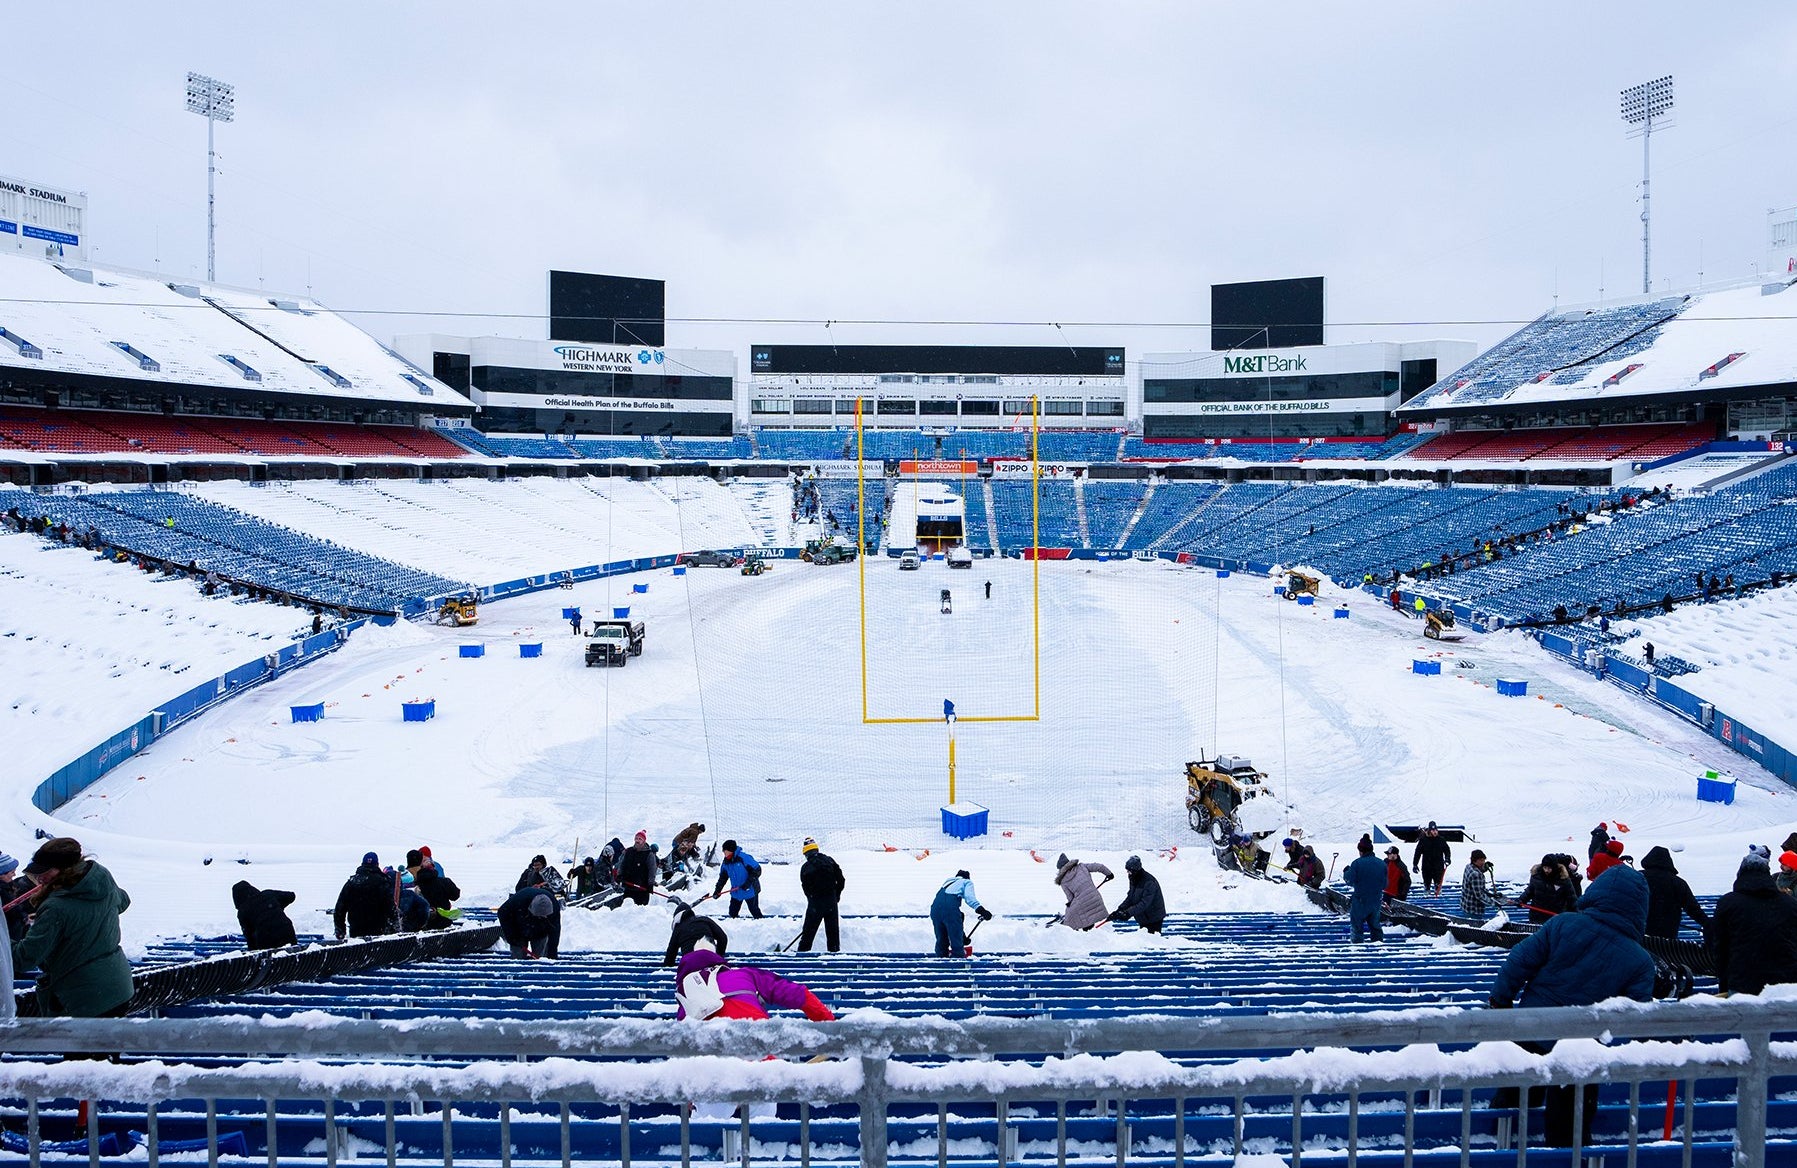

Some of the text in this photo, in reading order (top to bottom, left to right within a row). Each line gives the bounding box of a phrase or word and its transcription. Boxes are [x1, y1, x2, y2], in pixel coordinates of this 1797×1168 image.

[0, 181, 67, 204] MARK STADIUM
[562, 349, 632, 363] HIGHMARK
[563, 362, 633, 373] WESTERN NEW YORK
[1224, 354, 1307, 373] M&T Bank
[544, 398, 571, 406] Official
[571, 399, 594, 407] Health
[1201, 404, 1232, 412] OFFICIAL
[1279, 402, 1310, 410] BUFFALO
[1310, 401, 1330, 410] BILLS
[1770, 442, 1784, 451] 132
[743, 548, 785, 557] BUFFALO
[1131, 550, 1159, 559] BILLS
